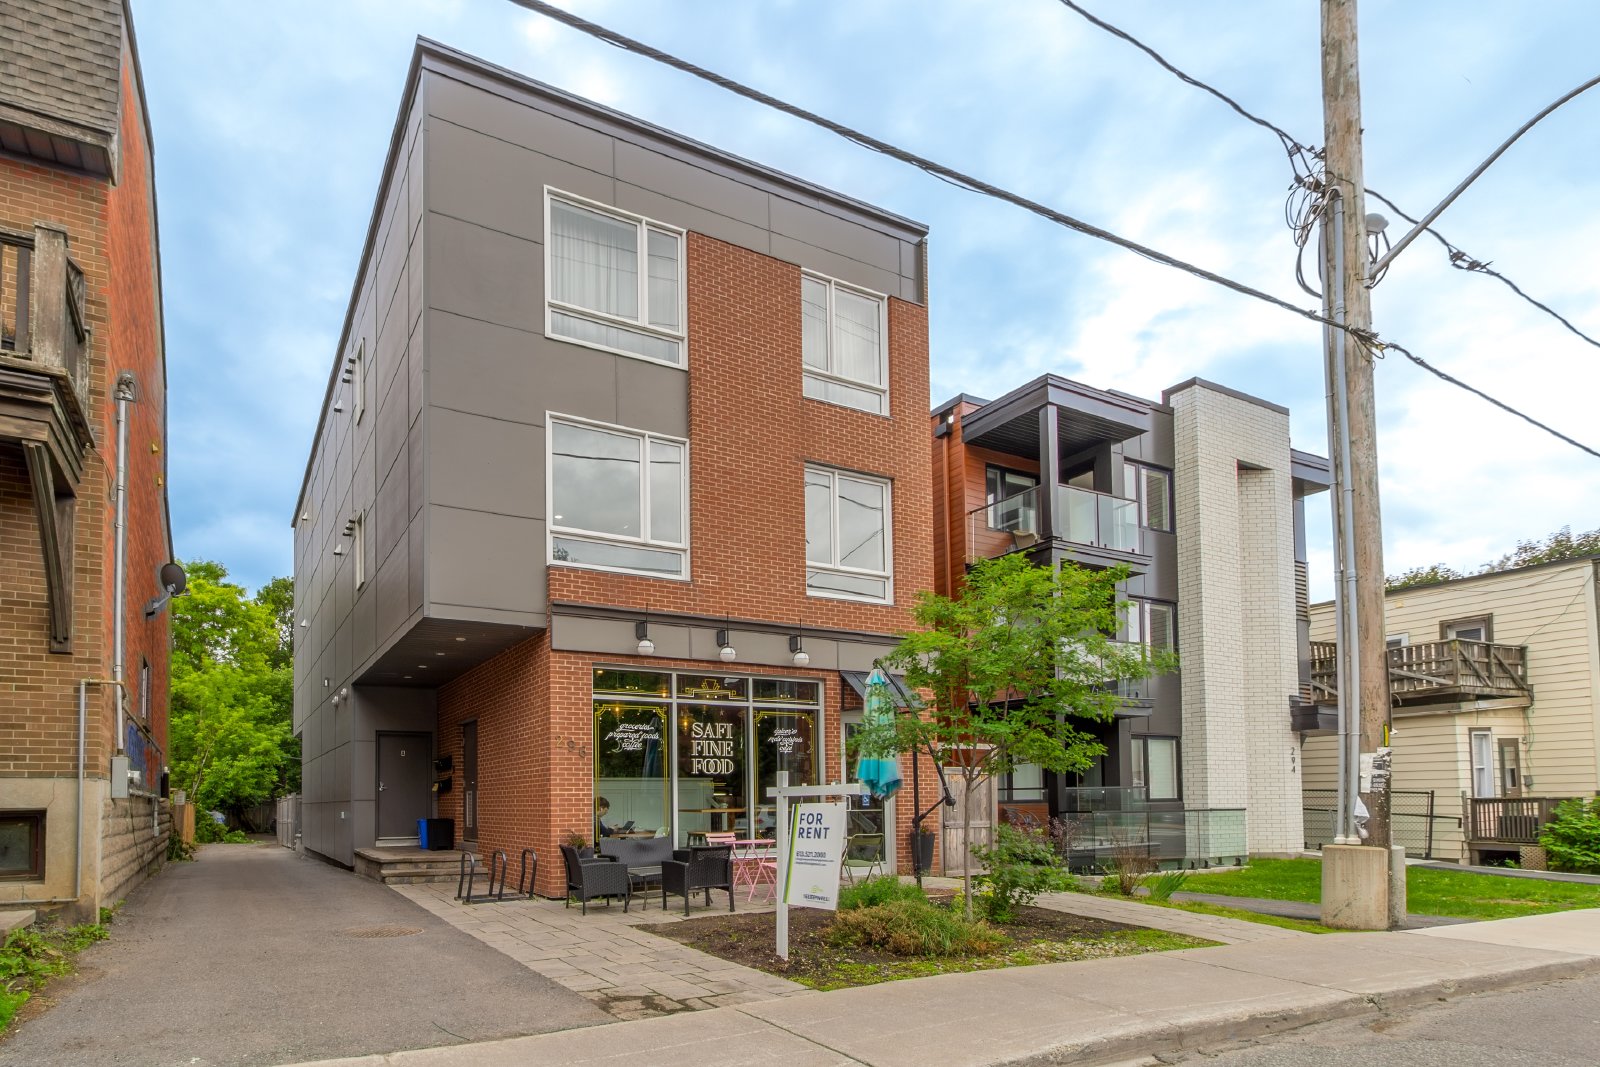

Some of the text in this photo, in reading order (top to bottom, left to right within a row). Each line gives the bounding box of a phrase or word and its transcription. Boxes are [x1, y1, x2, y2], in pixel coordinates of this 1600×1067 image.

[616, 723, 654, 732] groceries
[691, 722, 734, 739] SAFI
[604, 731, 643, 741] prepared
[555, 735, 587, 758] 296
[691, 740, 734, 757] FINE
[691, 758, 734, 775] FOOD
[799, 812, 823, 825] FOR
[798, 827, 830, 839] RENT
